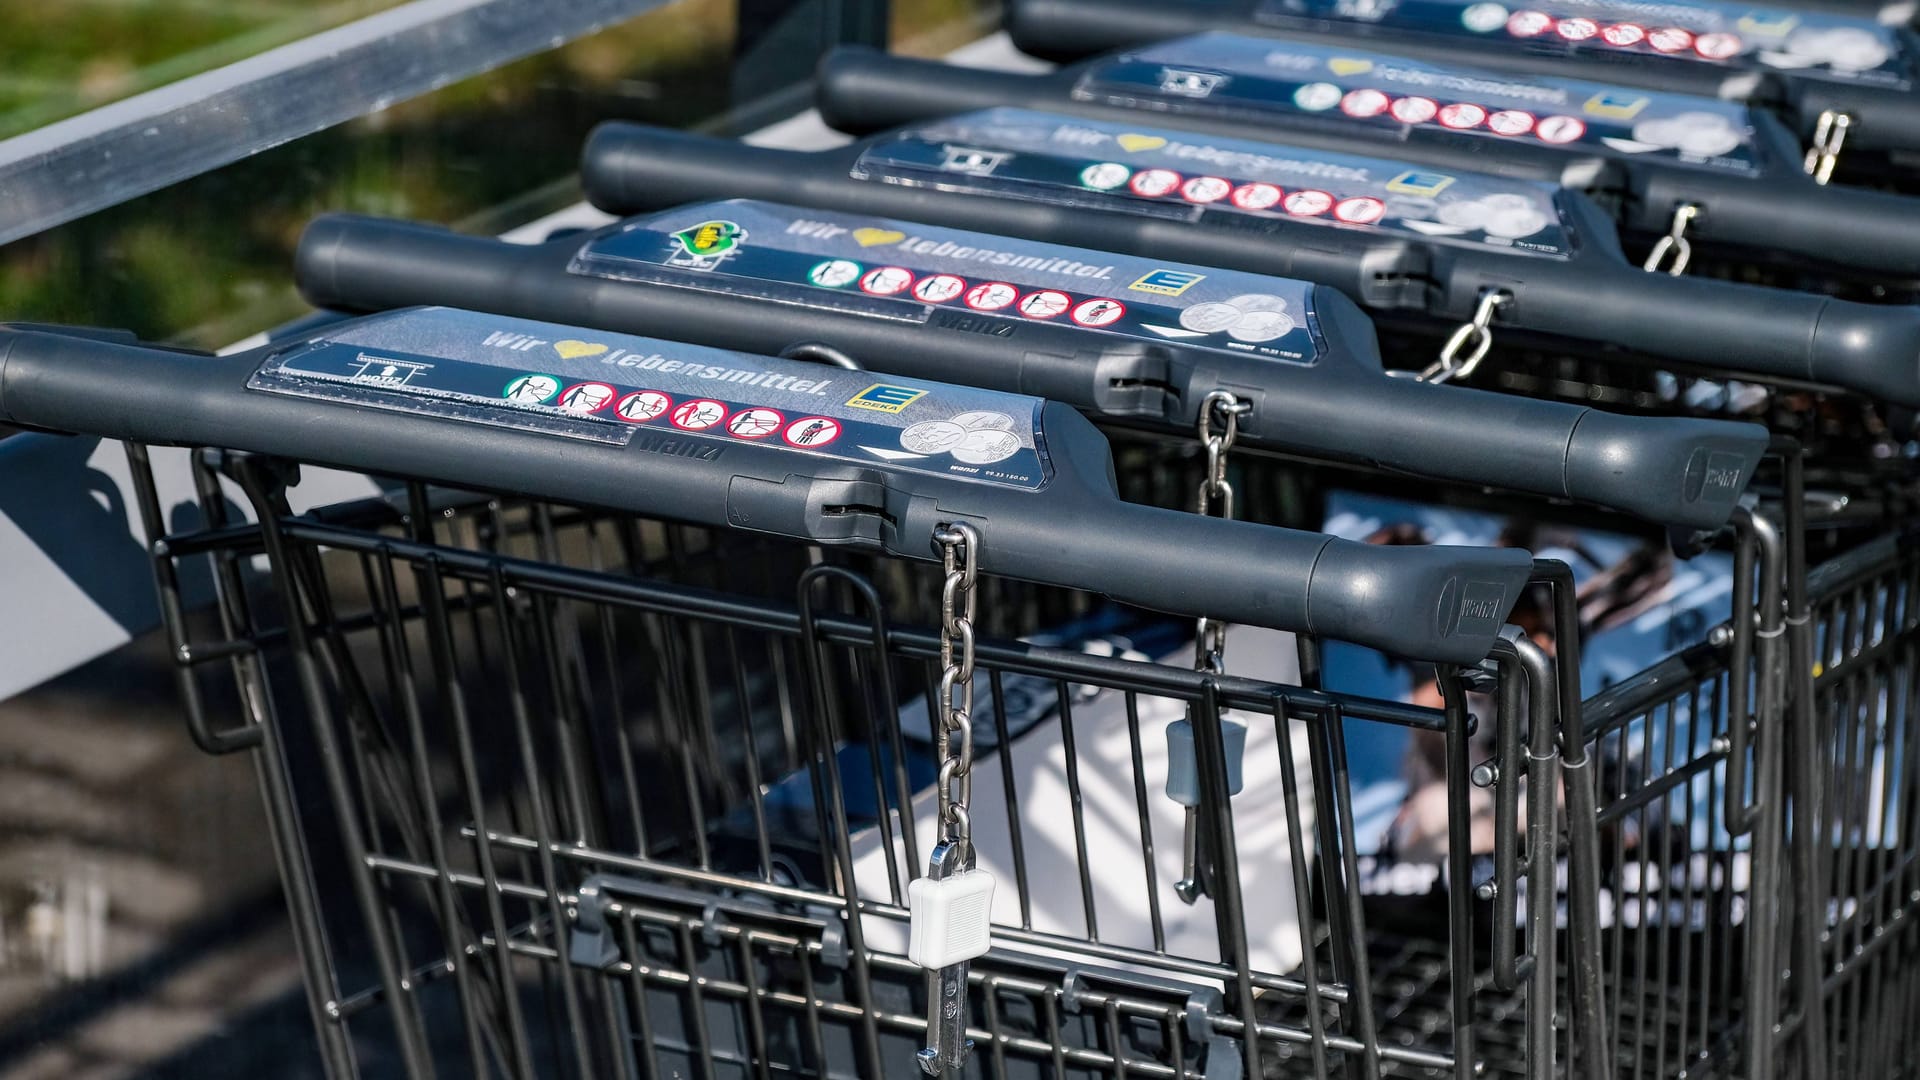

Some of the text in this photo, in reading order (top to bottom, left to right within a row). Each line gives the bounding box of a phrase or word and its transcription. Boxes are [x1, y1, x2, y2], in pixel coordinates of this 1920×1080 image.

[783, 219, 1116, 280] Wir Lebensmittel.
[482, 330, 833, 396] Wir Lebensmittel.
[852, 400, 898, 411] EDEKA
